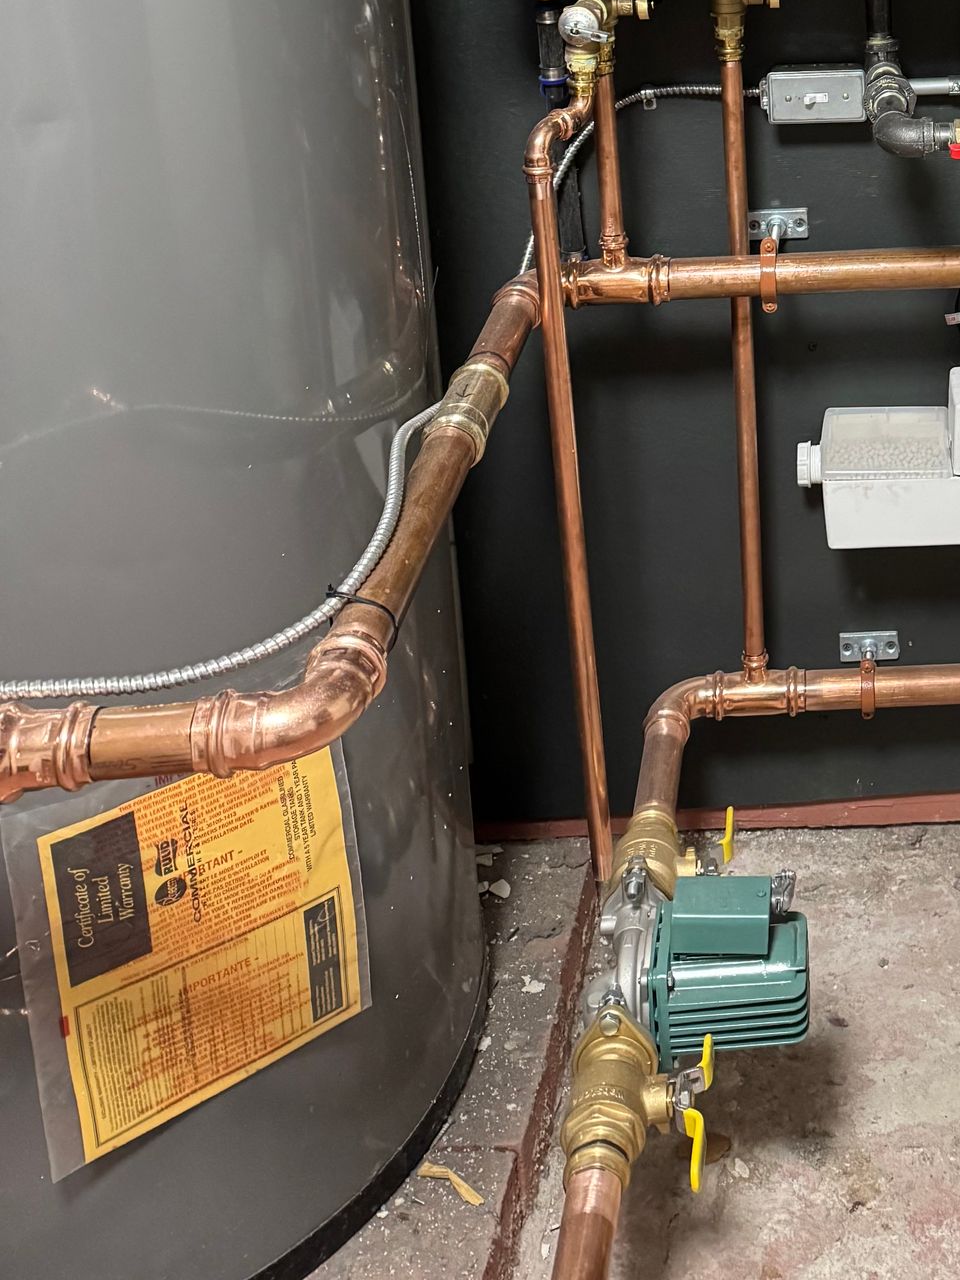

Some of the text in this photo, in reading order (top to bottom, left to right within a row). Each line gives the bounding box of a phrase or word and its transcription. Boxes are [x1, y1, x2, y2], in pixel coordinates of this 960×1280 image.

[301, 775, 311, 812] WARRANTY
[291, 810, 299, 840] STORAGE
[159, 840, 173, 874] RUUD
[178, 800, 202, 922] COMMERCIAL
[68, 866, 95, 948] Certificate of
[98, 876, 113, 923] Limited
[118, 863, 134, 919] Warranty
